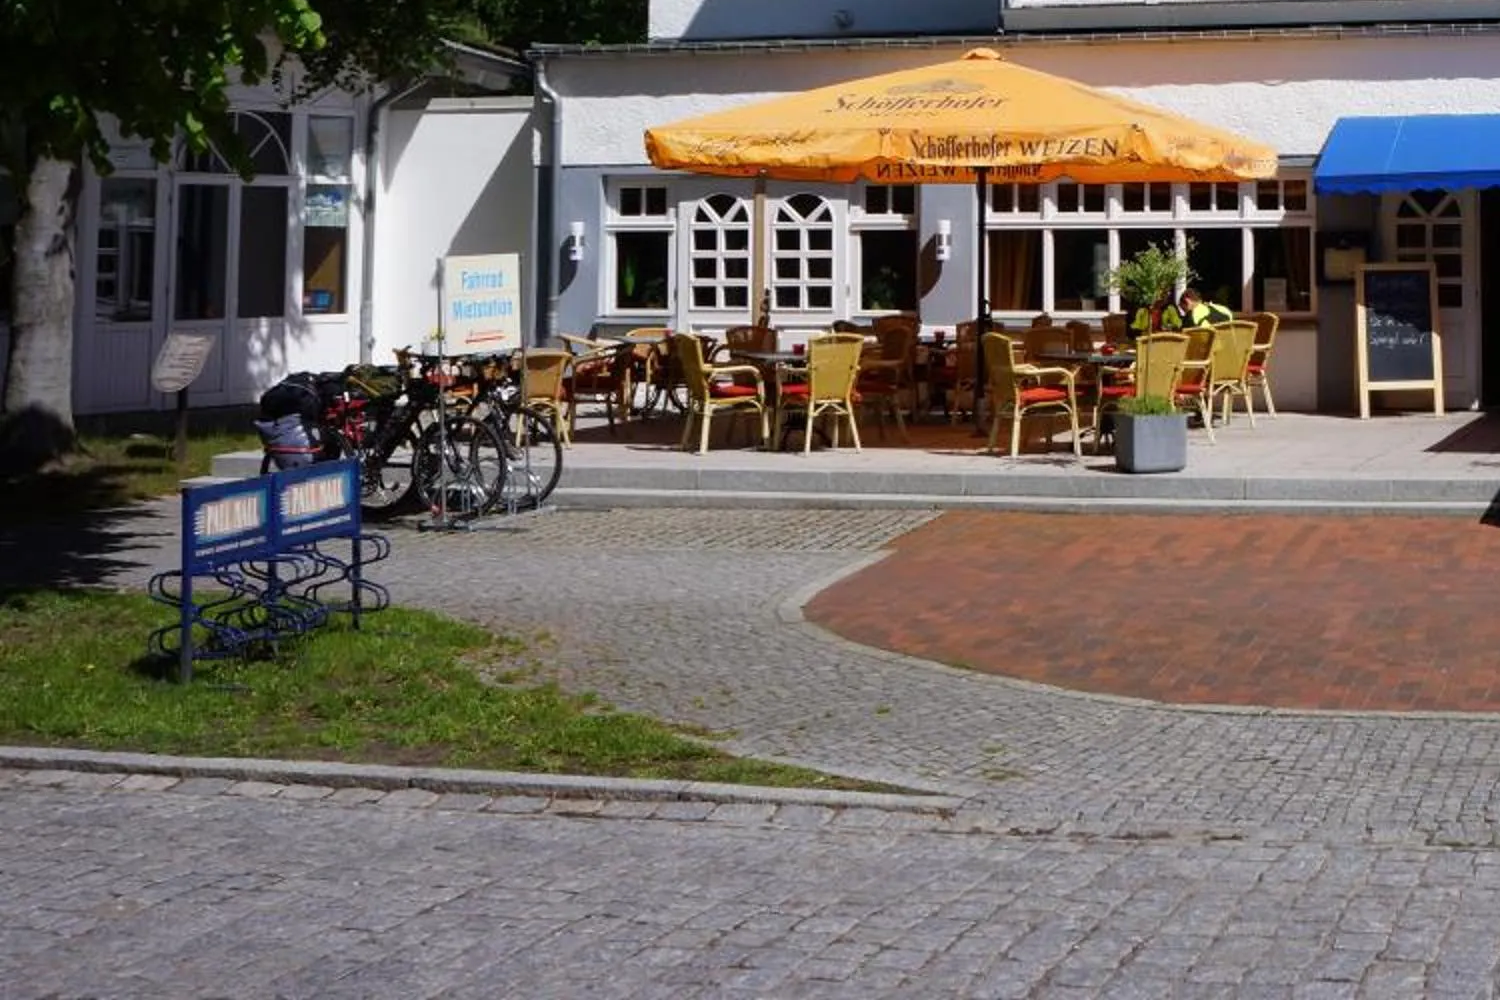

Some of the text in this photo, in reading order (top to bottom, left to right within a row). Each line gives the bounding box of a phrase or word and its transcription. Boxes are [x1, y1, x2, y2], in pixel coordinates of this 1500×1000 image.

[910, 131, 1119, 161] Schöfferhofer WEIZEN
[461, 270, 504, 290] Fahrrad
